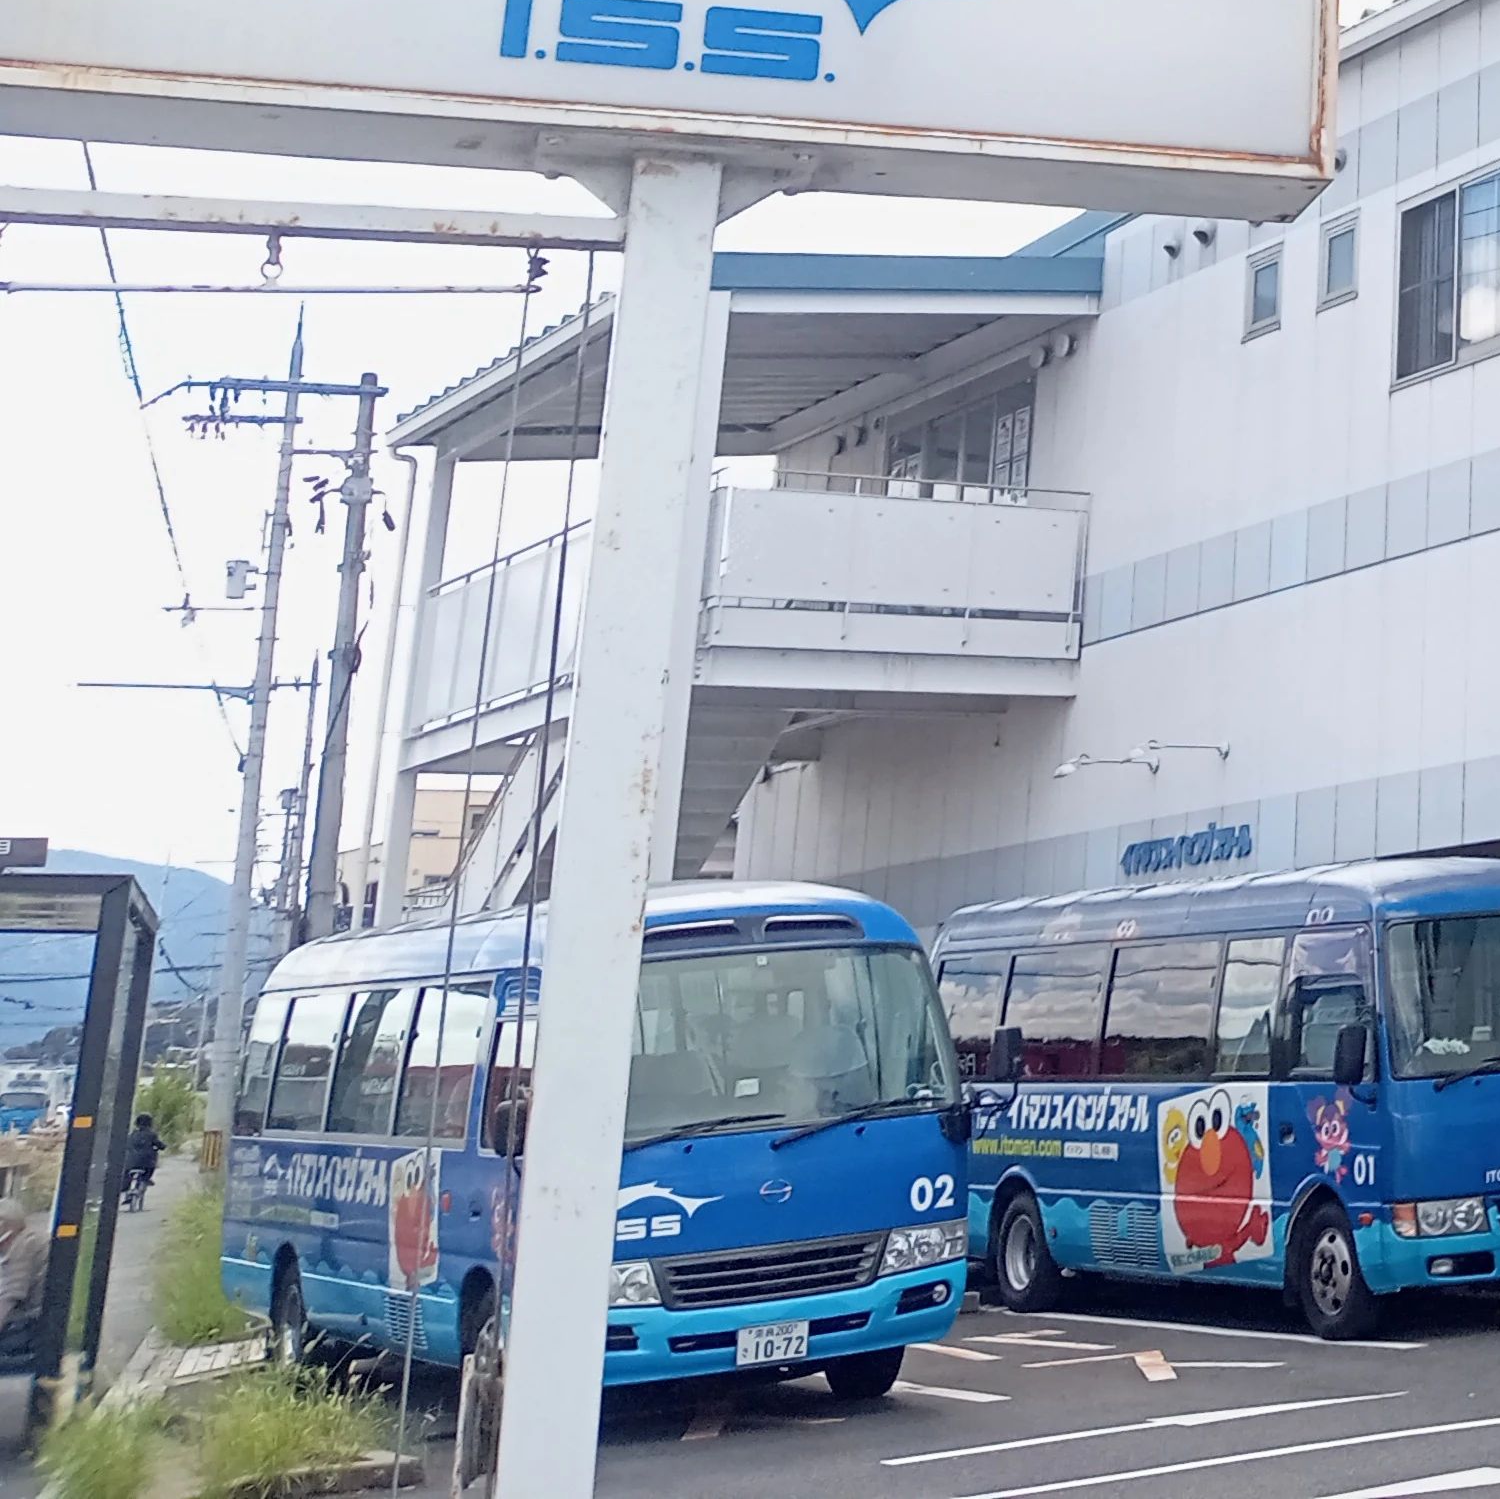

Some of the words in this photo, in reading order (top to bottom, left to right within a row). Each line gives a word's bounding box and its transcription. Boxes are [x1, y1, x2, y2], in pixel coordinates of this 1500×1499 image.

[1353, 1153, 1375, 1186] 01
[910, 1174, 955, 1213] 02
[616, 1214, 682, 1242] SS
[755, 1335, 805, 1360] 10-72
